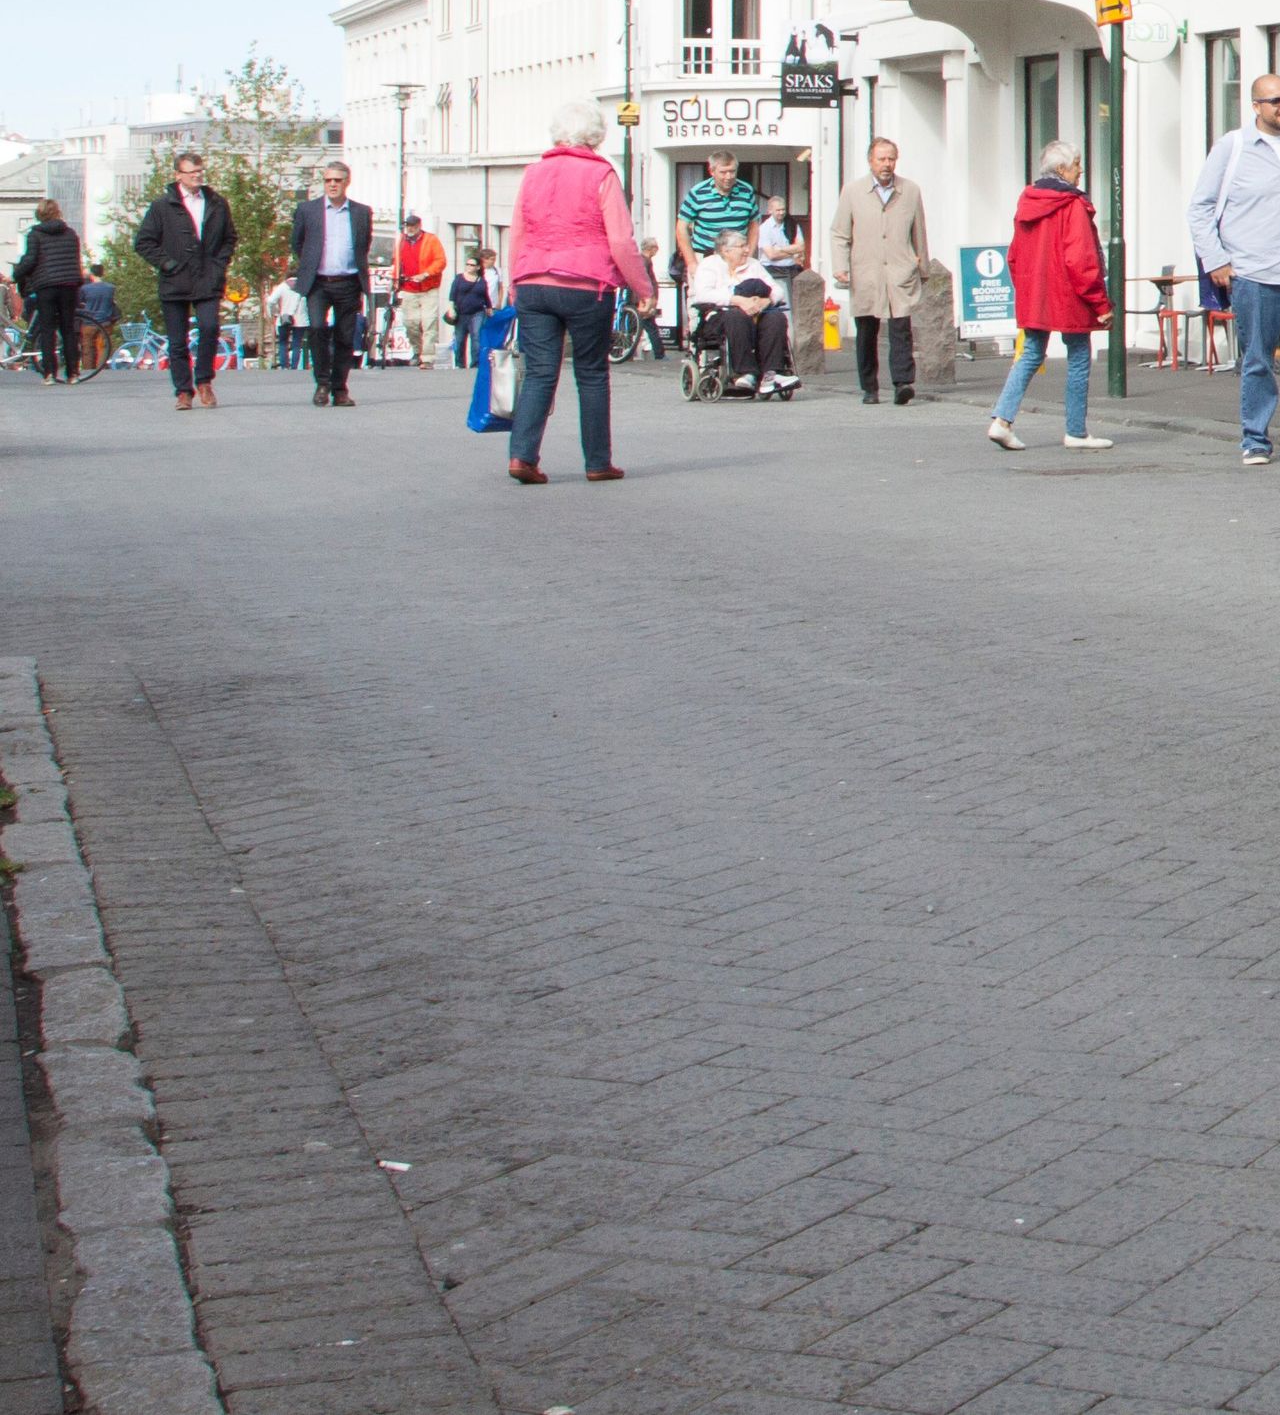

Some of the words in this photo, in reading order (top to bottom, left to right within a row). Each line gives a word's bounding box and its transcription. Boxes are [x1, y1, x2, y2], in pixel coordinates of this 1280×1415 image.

[785, 74, 834, 89] SPAKS
[667, 124, 724, 138] BISTRO
[737, 124, 778, 137] BAR
